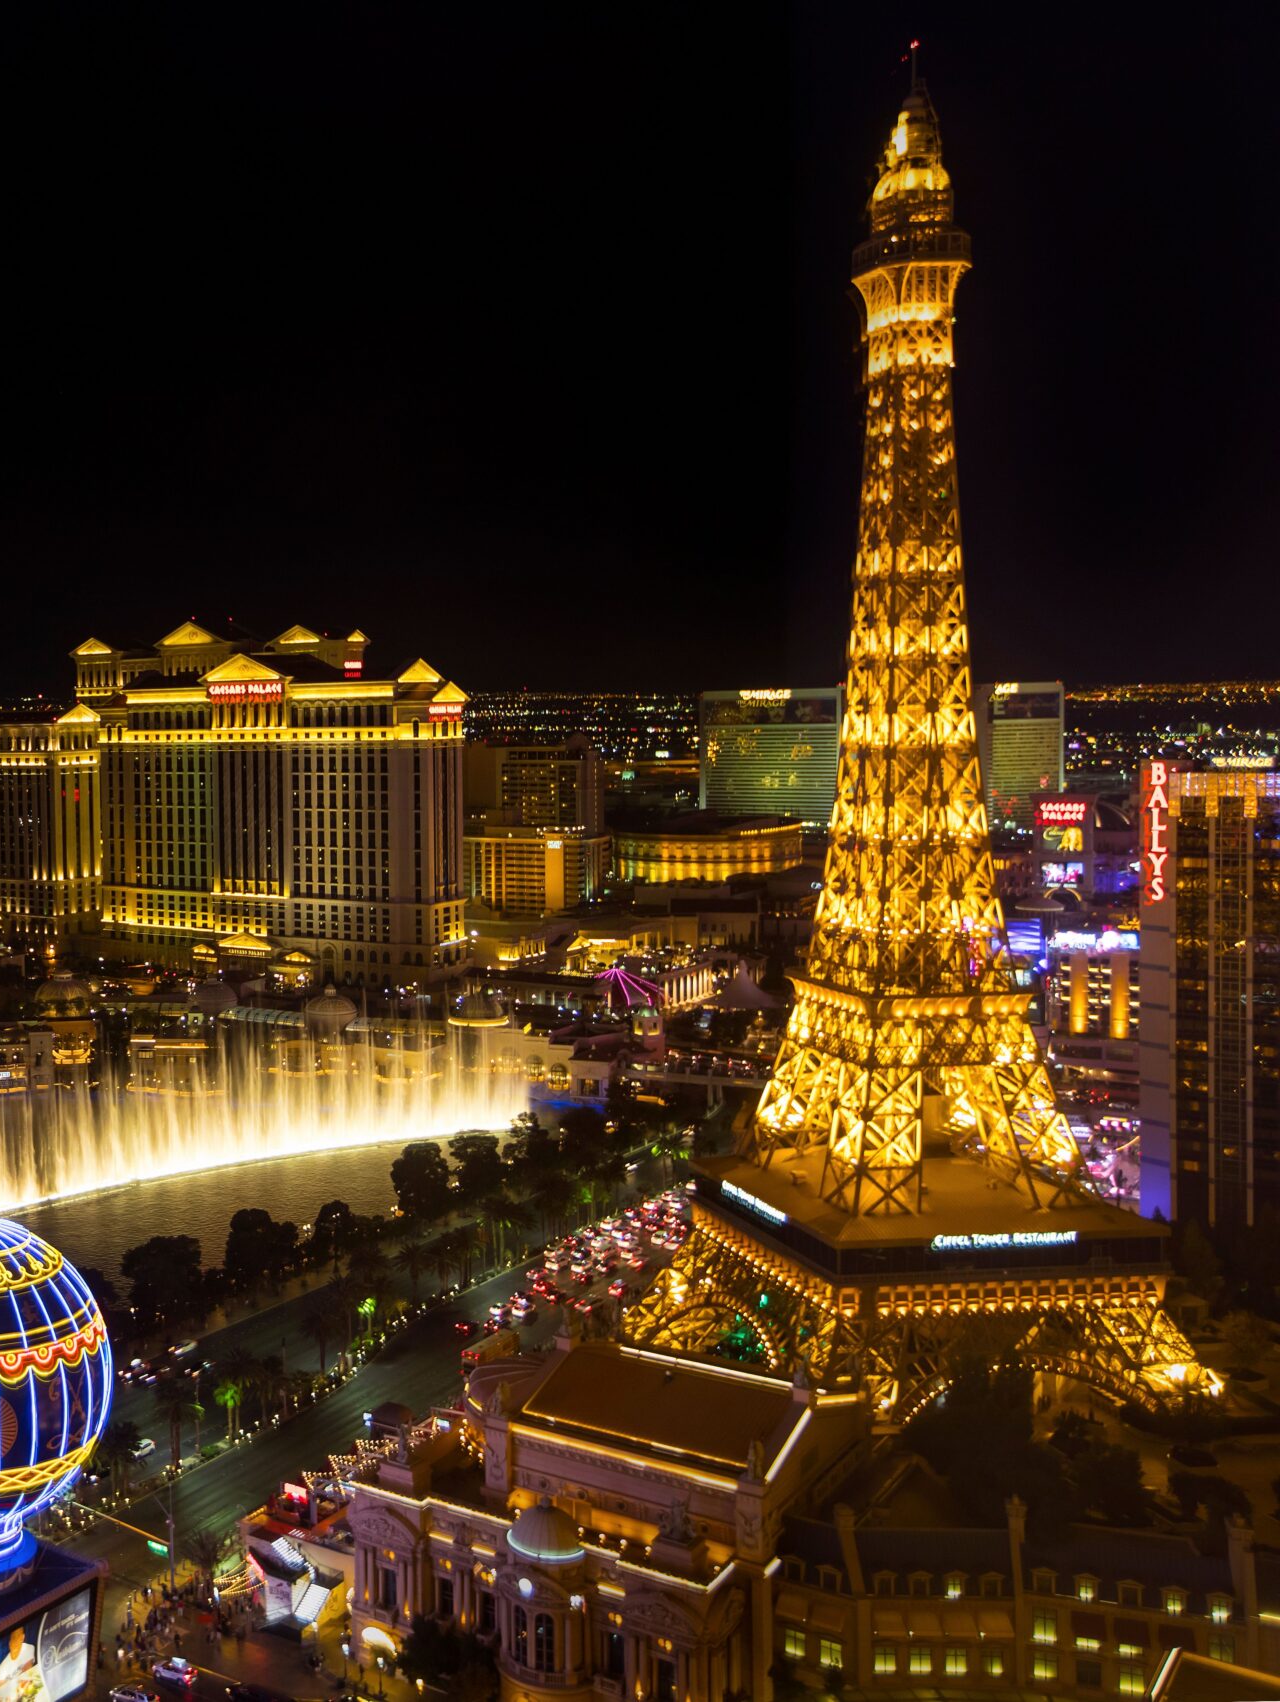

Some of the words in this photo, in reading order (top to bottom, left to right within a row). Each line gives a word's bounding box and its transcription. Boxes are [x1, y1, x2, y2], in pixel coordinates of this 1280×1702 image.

[209, 684, 246, 695] CAESARS
[248, 683, 282, 694] PALACE
[750, 688, 792, 700] MIRAGE
[1227, 756, 1274, 768] MIRAGE
[1040, 803, 1086, 812] CAESARS
[1042, 811, 1084, 821] PALACE
[934, 1234, 970, 1247] EIFFEL
[971, 1233, 1010, 1245] TOWER
[1013, 1231, 1078, 1244] RESTAURANT
